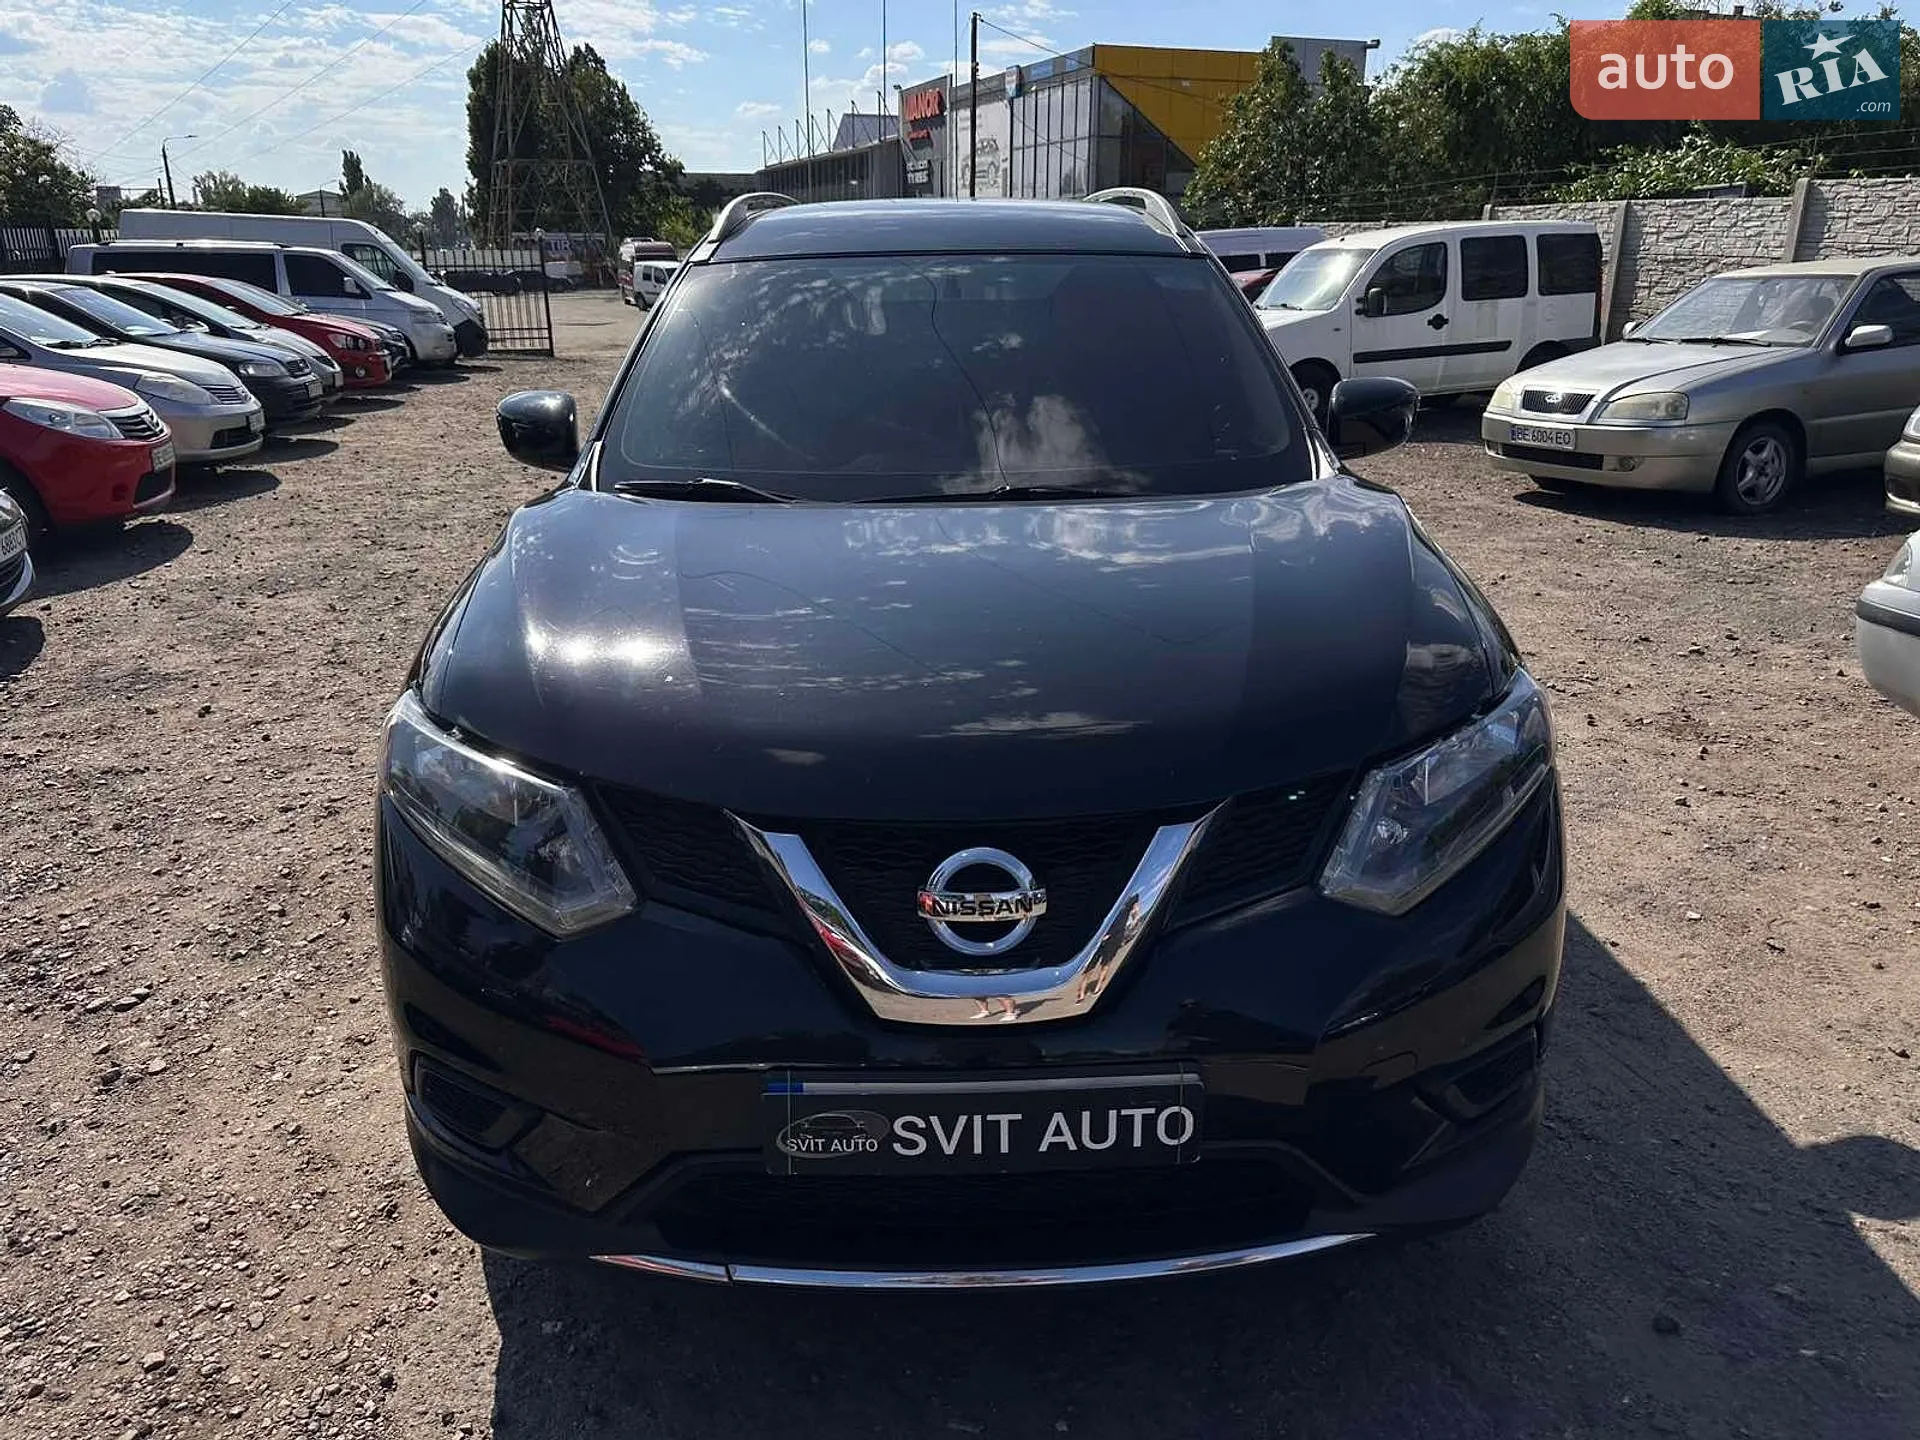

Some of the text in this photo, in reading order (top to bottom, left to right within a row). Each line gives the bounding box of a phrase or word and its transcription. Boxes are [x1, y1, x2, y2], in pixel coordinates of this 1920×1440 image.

[931, 895, 1034, 917] NISSAN
[893, 1105, 1194, 1157] SVIT AUTO
[786, 1138, 879, 1153] SVIT AUTO
